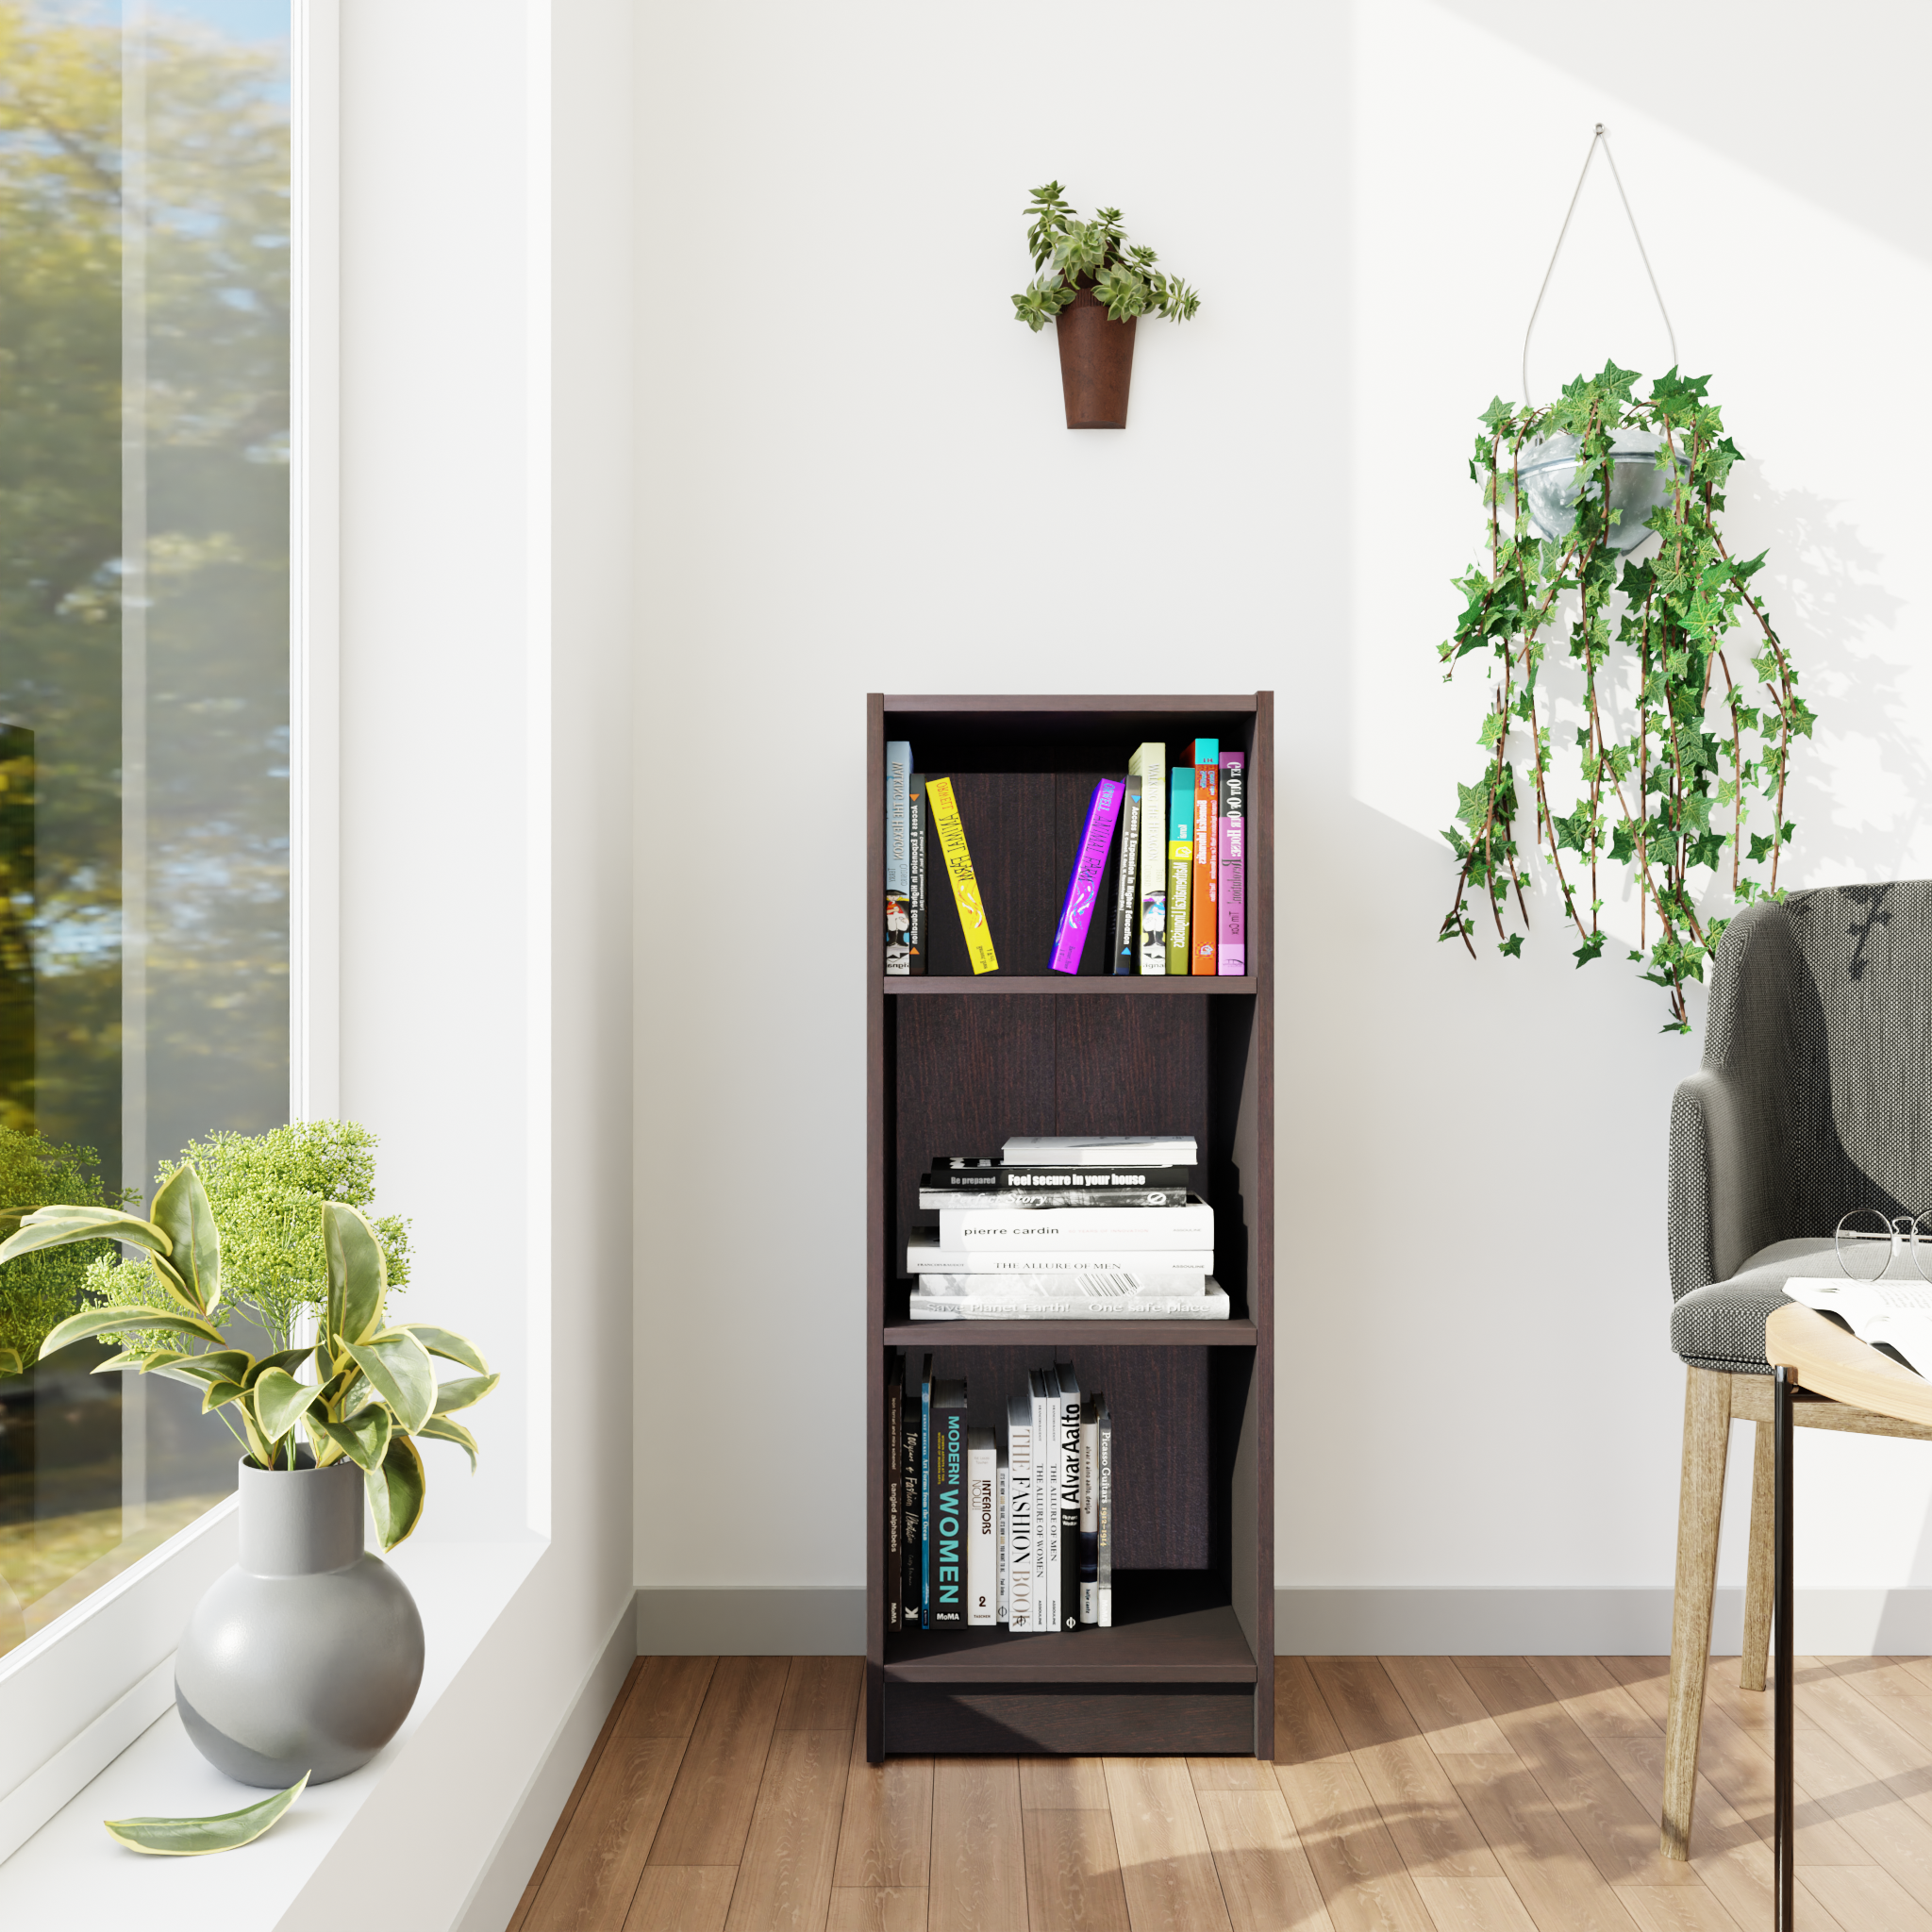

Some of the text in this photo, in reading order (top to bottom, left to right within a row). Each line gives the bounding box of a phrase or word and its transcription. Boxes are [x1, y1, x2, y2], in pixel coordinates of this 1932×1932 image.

[1097, 782, 1116, 811] ORWELL
[1147, 762, 1160, 861] WALKING THE HEXAGON
[1130, 806, 1139, 831] Access
[1077, 812, 1113, 882] ANIMAL FARM
[1127, 840, 1137, 875] Expansion
[1124, 885, 1134, 908] Higher
[1123, 909, 1133, 945] Education
[951, 1174, 1145, 1187] Be prepared Feel secure in your house
[1006, 1193, 1047, 1206] Story
[964, 1227, 1008, 1236] pierre
[926, 1302, 1211, 1314] Save Planet Earth! One safe place
[1101, 1431, 1111, 1466] Picasso
[905, 1476, 918, 1507] Fashion
[973, 1479, 982, 1510] NOW!
[1101, 1467, 1111, 1504] Guitars
[940, 1415, 960, 1603] MODERN WOMEN
[982, 1479, 991, 1535] INTERIORS
[1083, 1495, 1092, 1515] design
[889, 1514, 897, 1553] alphabets
[1012, 1428, 1031, 1628] THE FASHION BOOK
[1036, 1524, 1043, 1538] OF
[1050, 1524, 1058, 1538] OF
[937, 1612, 959, 1621] MoMA
[979, 1596, 987, 1607] 2
